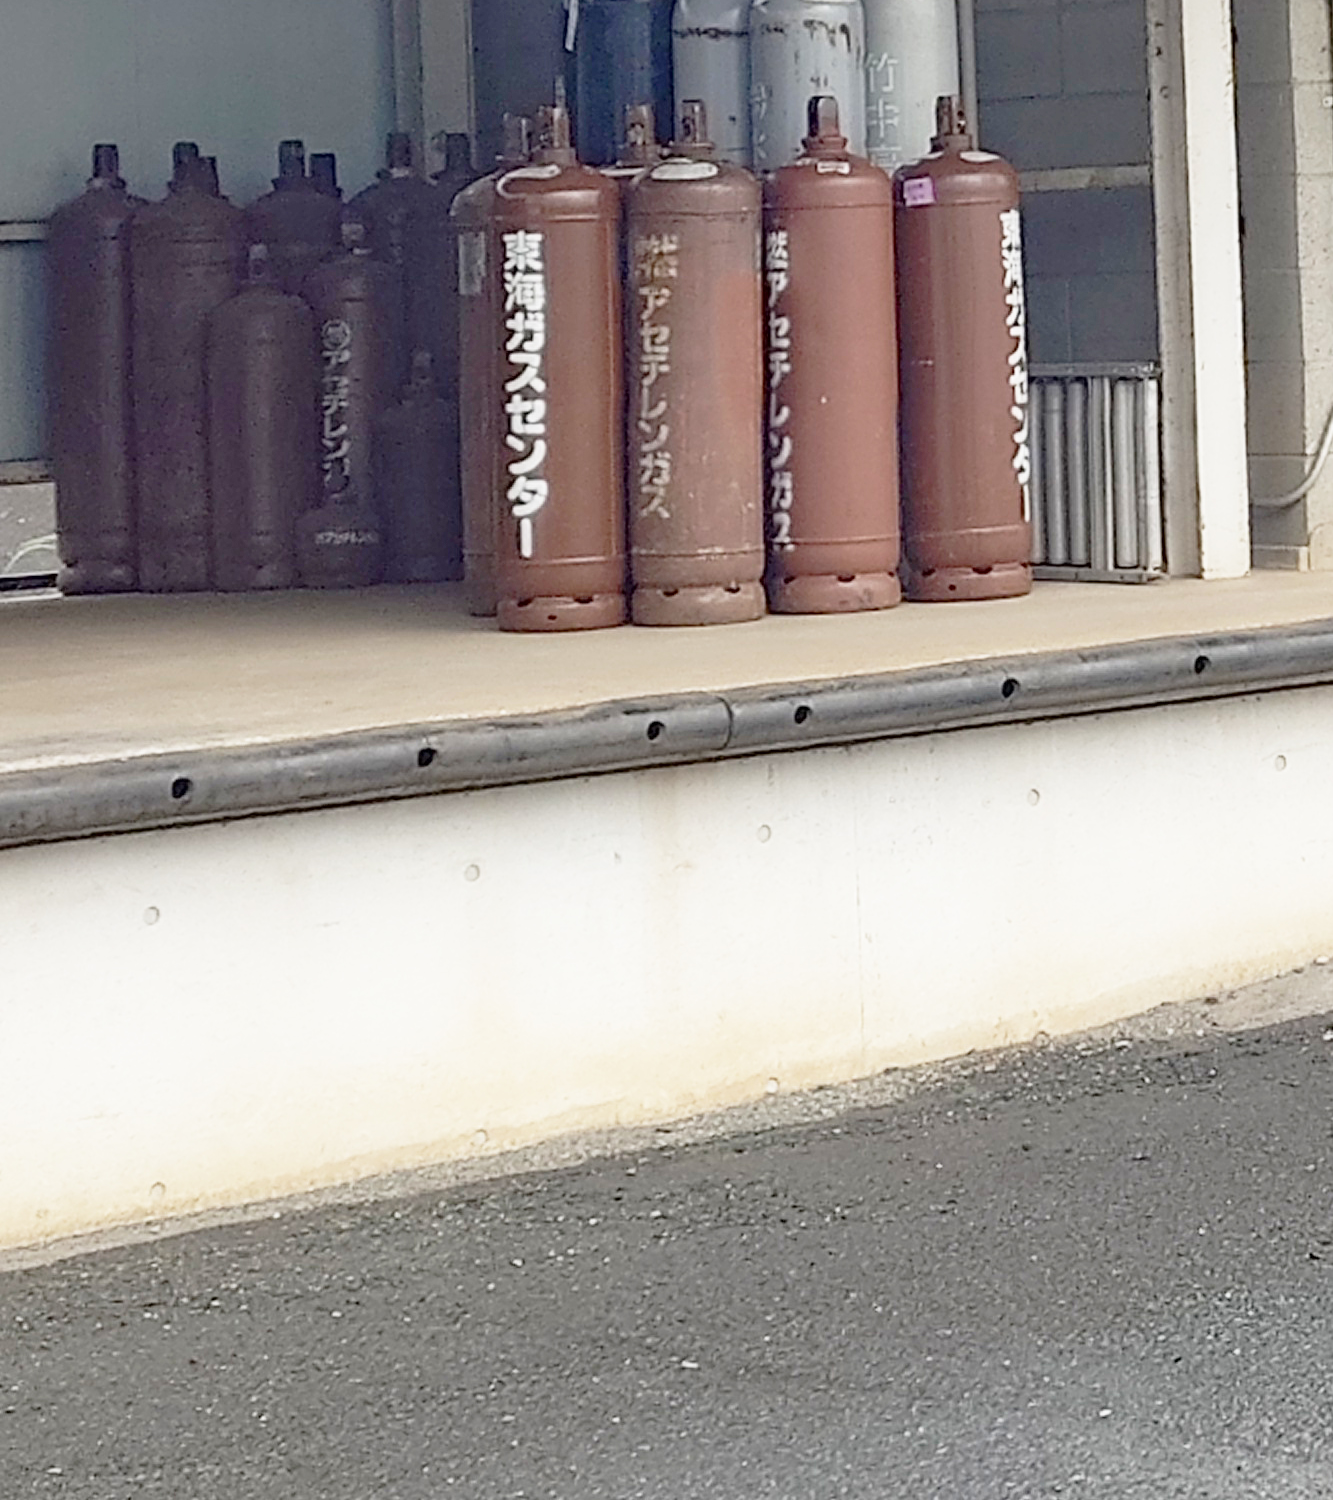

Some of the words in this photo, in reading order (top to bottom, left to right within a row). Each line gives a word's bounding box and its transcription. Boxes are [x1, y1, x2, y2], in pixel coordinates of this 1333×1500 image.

[502, 230, 546, 558] 東海ガスセンター
